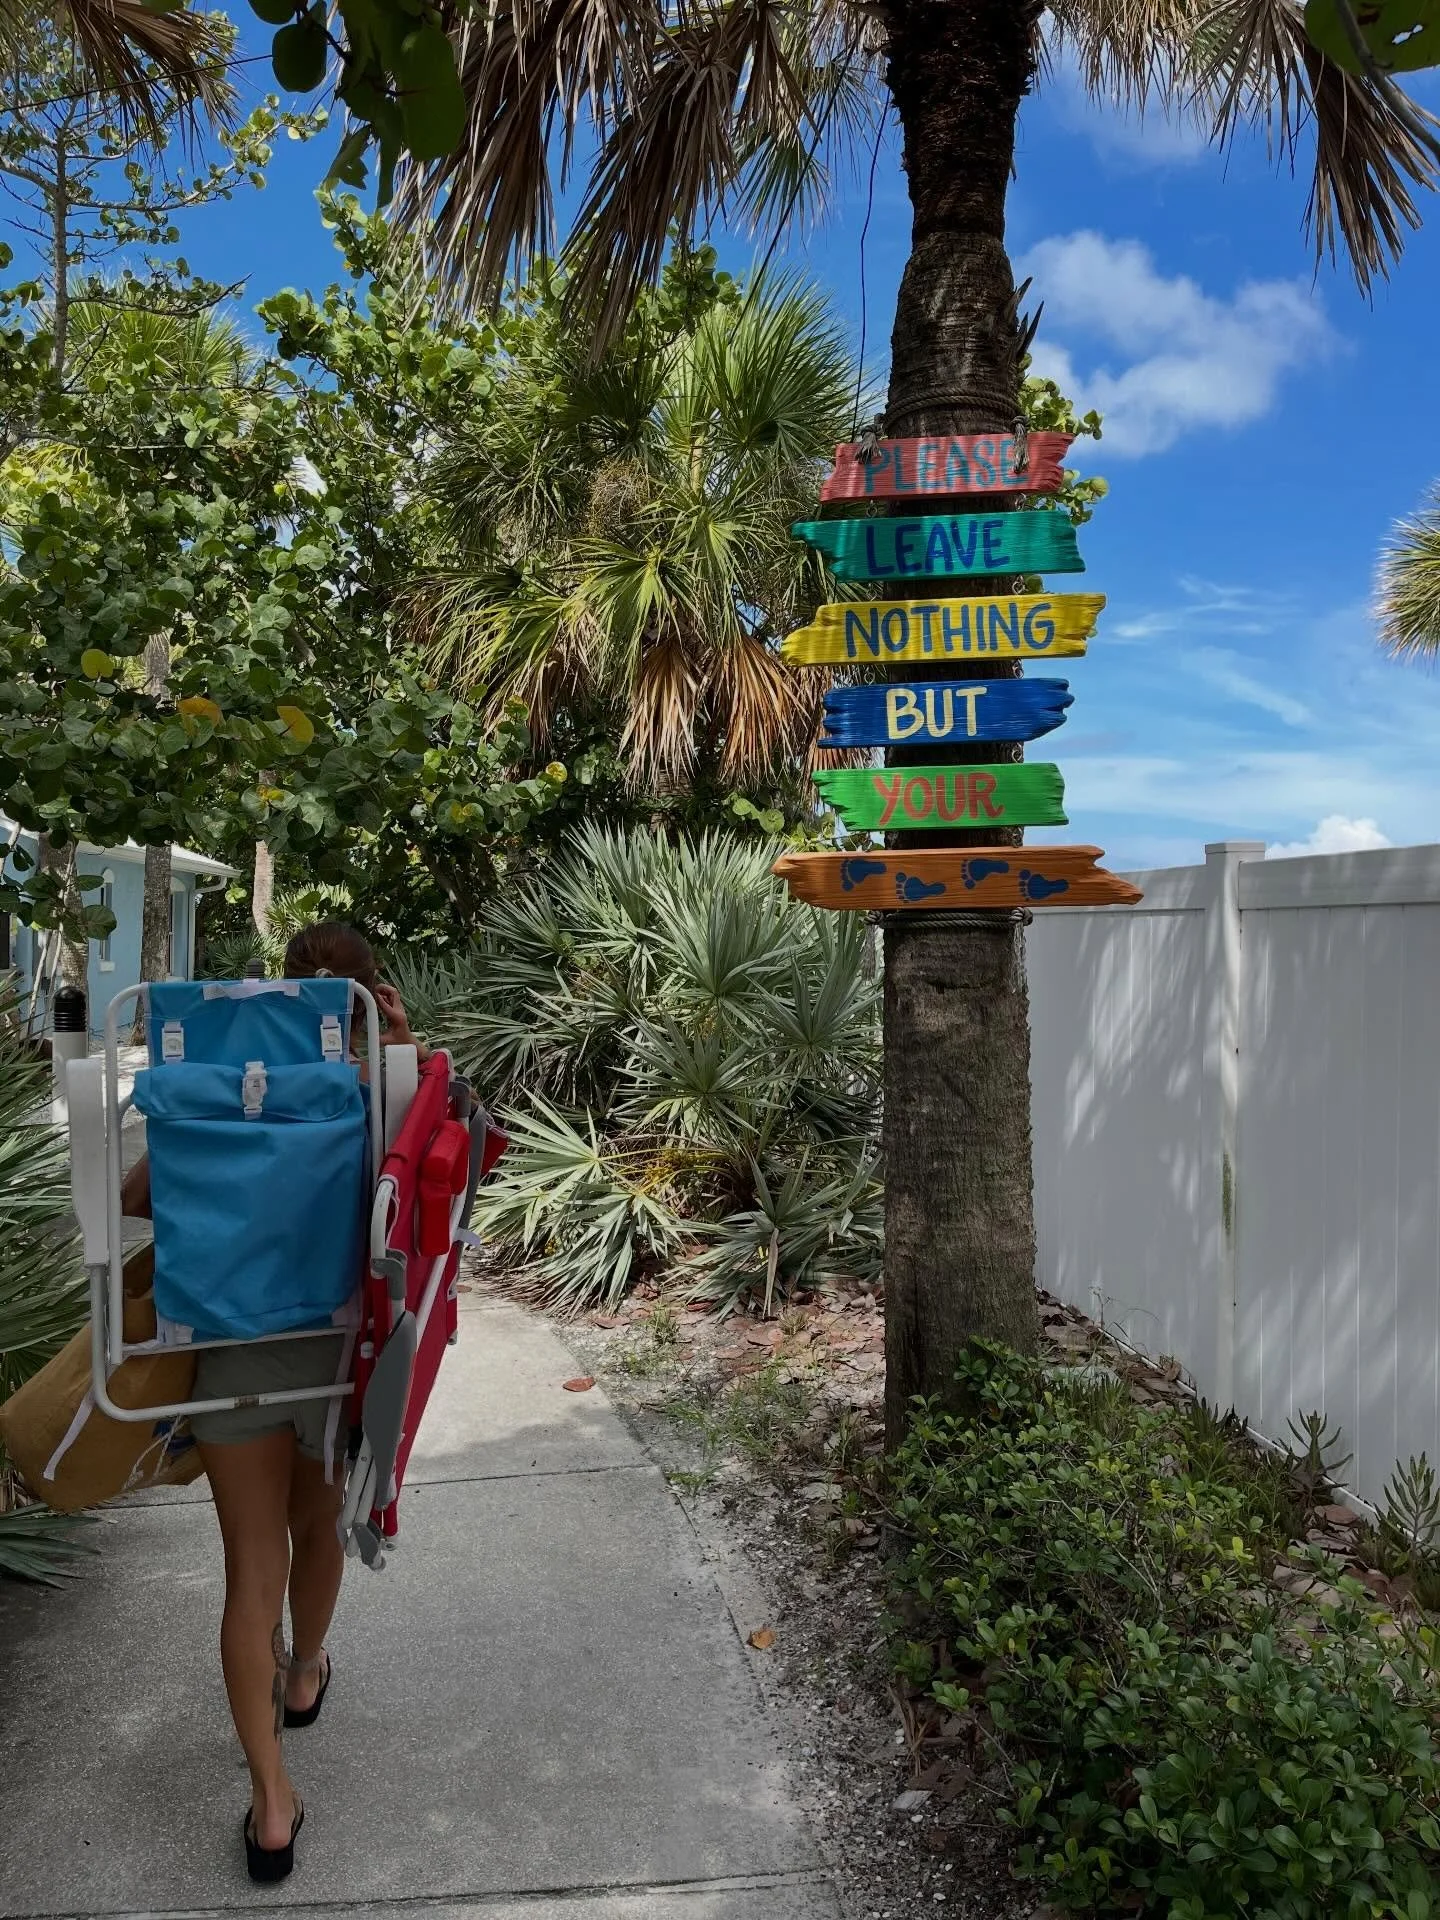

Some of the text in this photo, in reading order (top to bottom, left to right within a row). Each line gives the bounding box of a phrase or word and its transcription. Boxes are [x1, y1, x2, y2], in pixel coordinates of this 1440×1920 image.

[863, 439, 1029, 494] PLEASE
[866, 519, 1010, 576] LEAVE
[845, 602, 1055, 657] NOTHING
[886, 686, 987, 740] BUT
[872, 773, 1005, 827] YOUR
